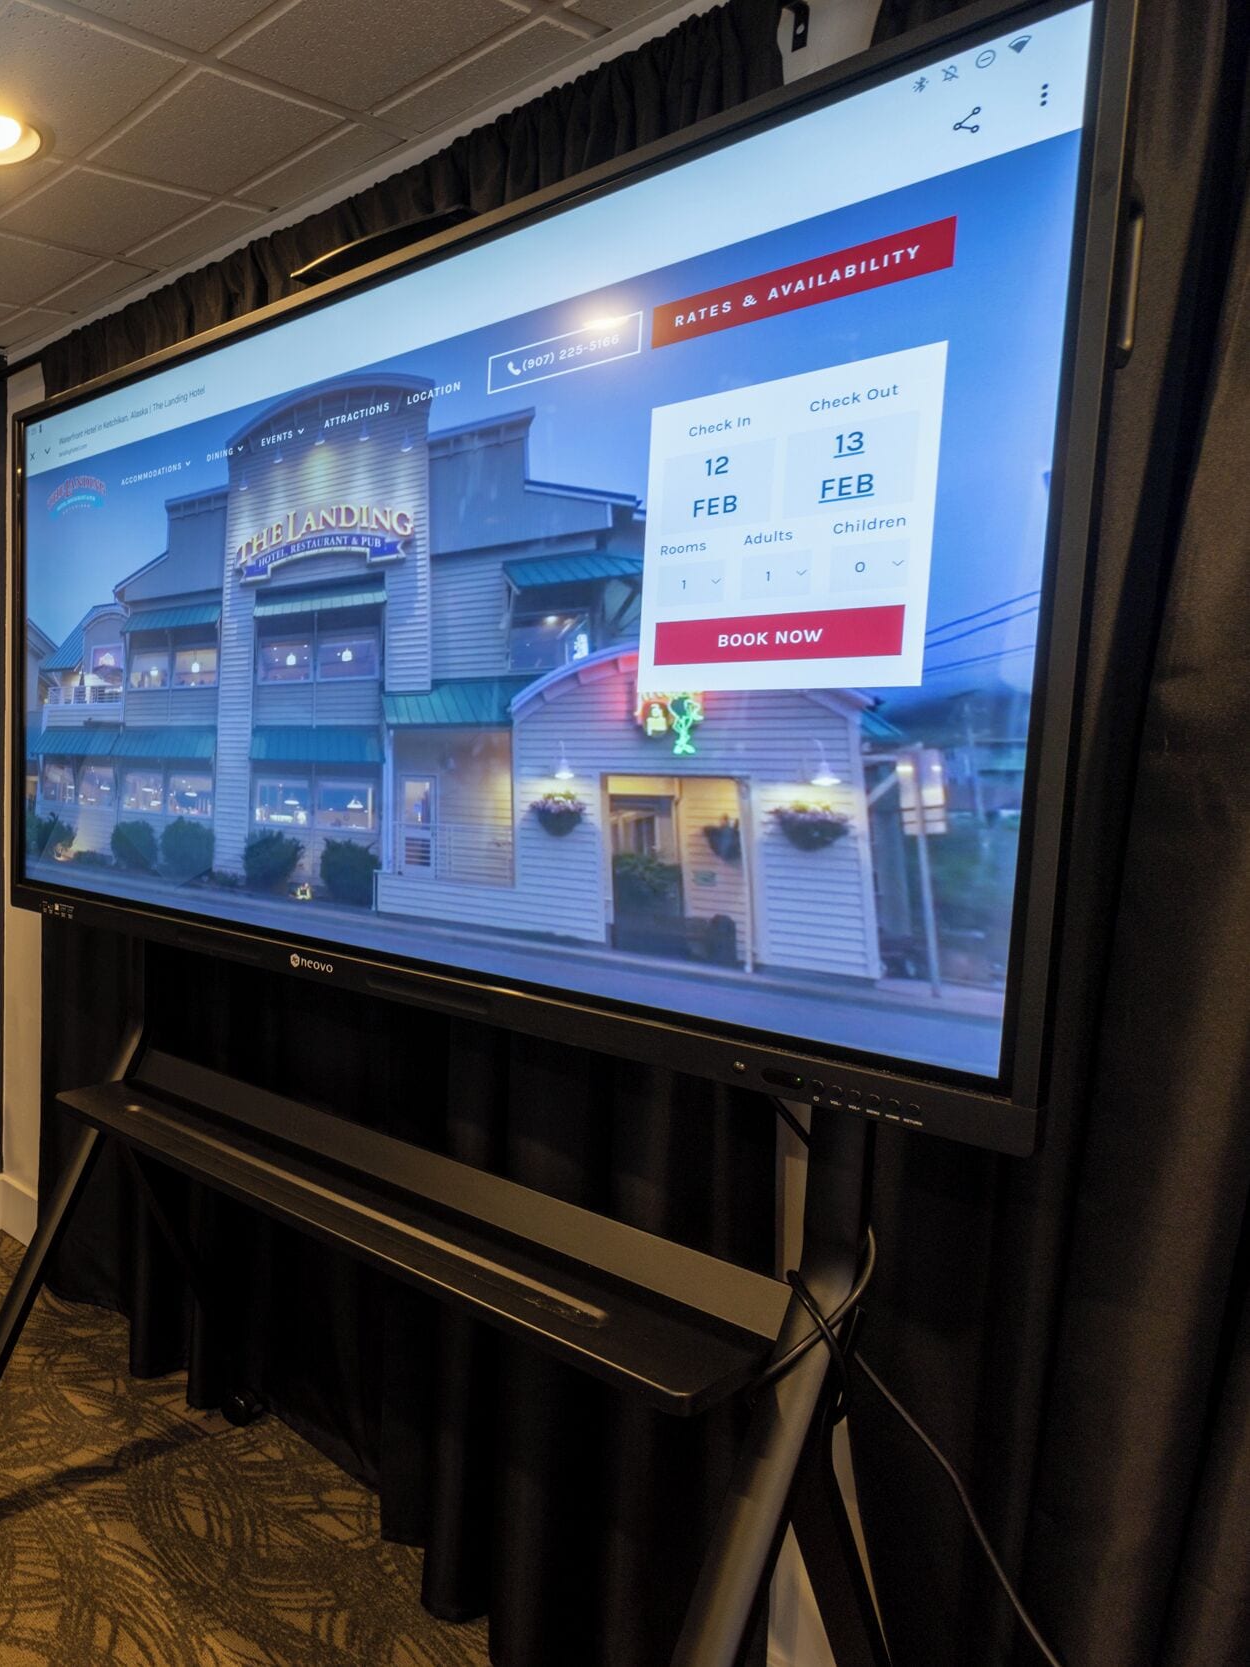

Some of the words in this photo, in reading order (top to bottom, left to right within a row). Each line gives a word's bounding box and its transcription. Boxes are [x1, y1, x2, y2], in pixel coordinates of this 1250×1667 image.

[675, 300, 732, 328] RATES
[742, 294, 758, 308] &
[768, 244, 921, 301] AVAILABILITY
[522, 351, 554, 372] (907)
[559, 334, 620, 360] 225-5166
[130, 408, 149, 420] Alaska
[152, 401, 163, 412] The
[164, 394, 188, 408] Landing
[189, 385, 206, 398] Hotel
[407, 381, 461, 405] LOCATION
[809, 391, 862, 413] Check
[867, 384, 899, 401] Out
[324, 402, 390, 428] ATTRACTIONS
[689, 419, 732, 437] Check
[736, 415, 752, 429] In
[261, 430, 293, 447] EVENTS
[834, 431, 865, 456] 13
[206, 447, 234, 462] DINING
[121, 463, 182, 486] ACCOMMODATIONS
[705, 456, 730, 477] 12
[819, 473, 875, 500] FEB
[693, 495, 738, 518] FEB
[237, 521, 283, 566] THE
[286, 503, 415, 537] LANDING
[833, 515, 907, 535] Children
[290, 536, 350, 554] RESTAURANT
[361, 536, 382, 548] PUB
[660, 540, 707, 556] Rooms
[744, 529, 793, 547] Adults
[854, 561, 866, 573] 0
[717, 631, 769, 648] BOOK
[775, 628, 823, 645] NOW
[301, 958, 334, 973] neovo
